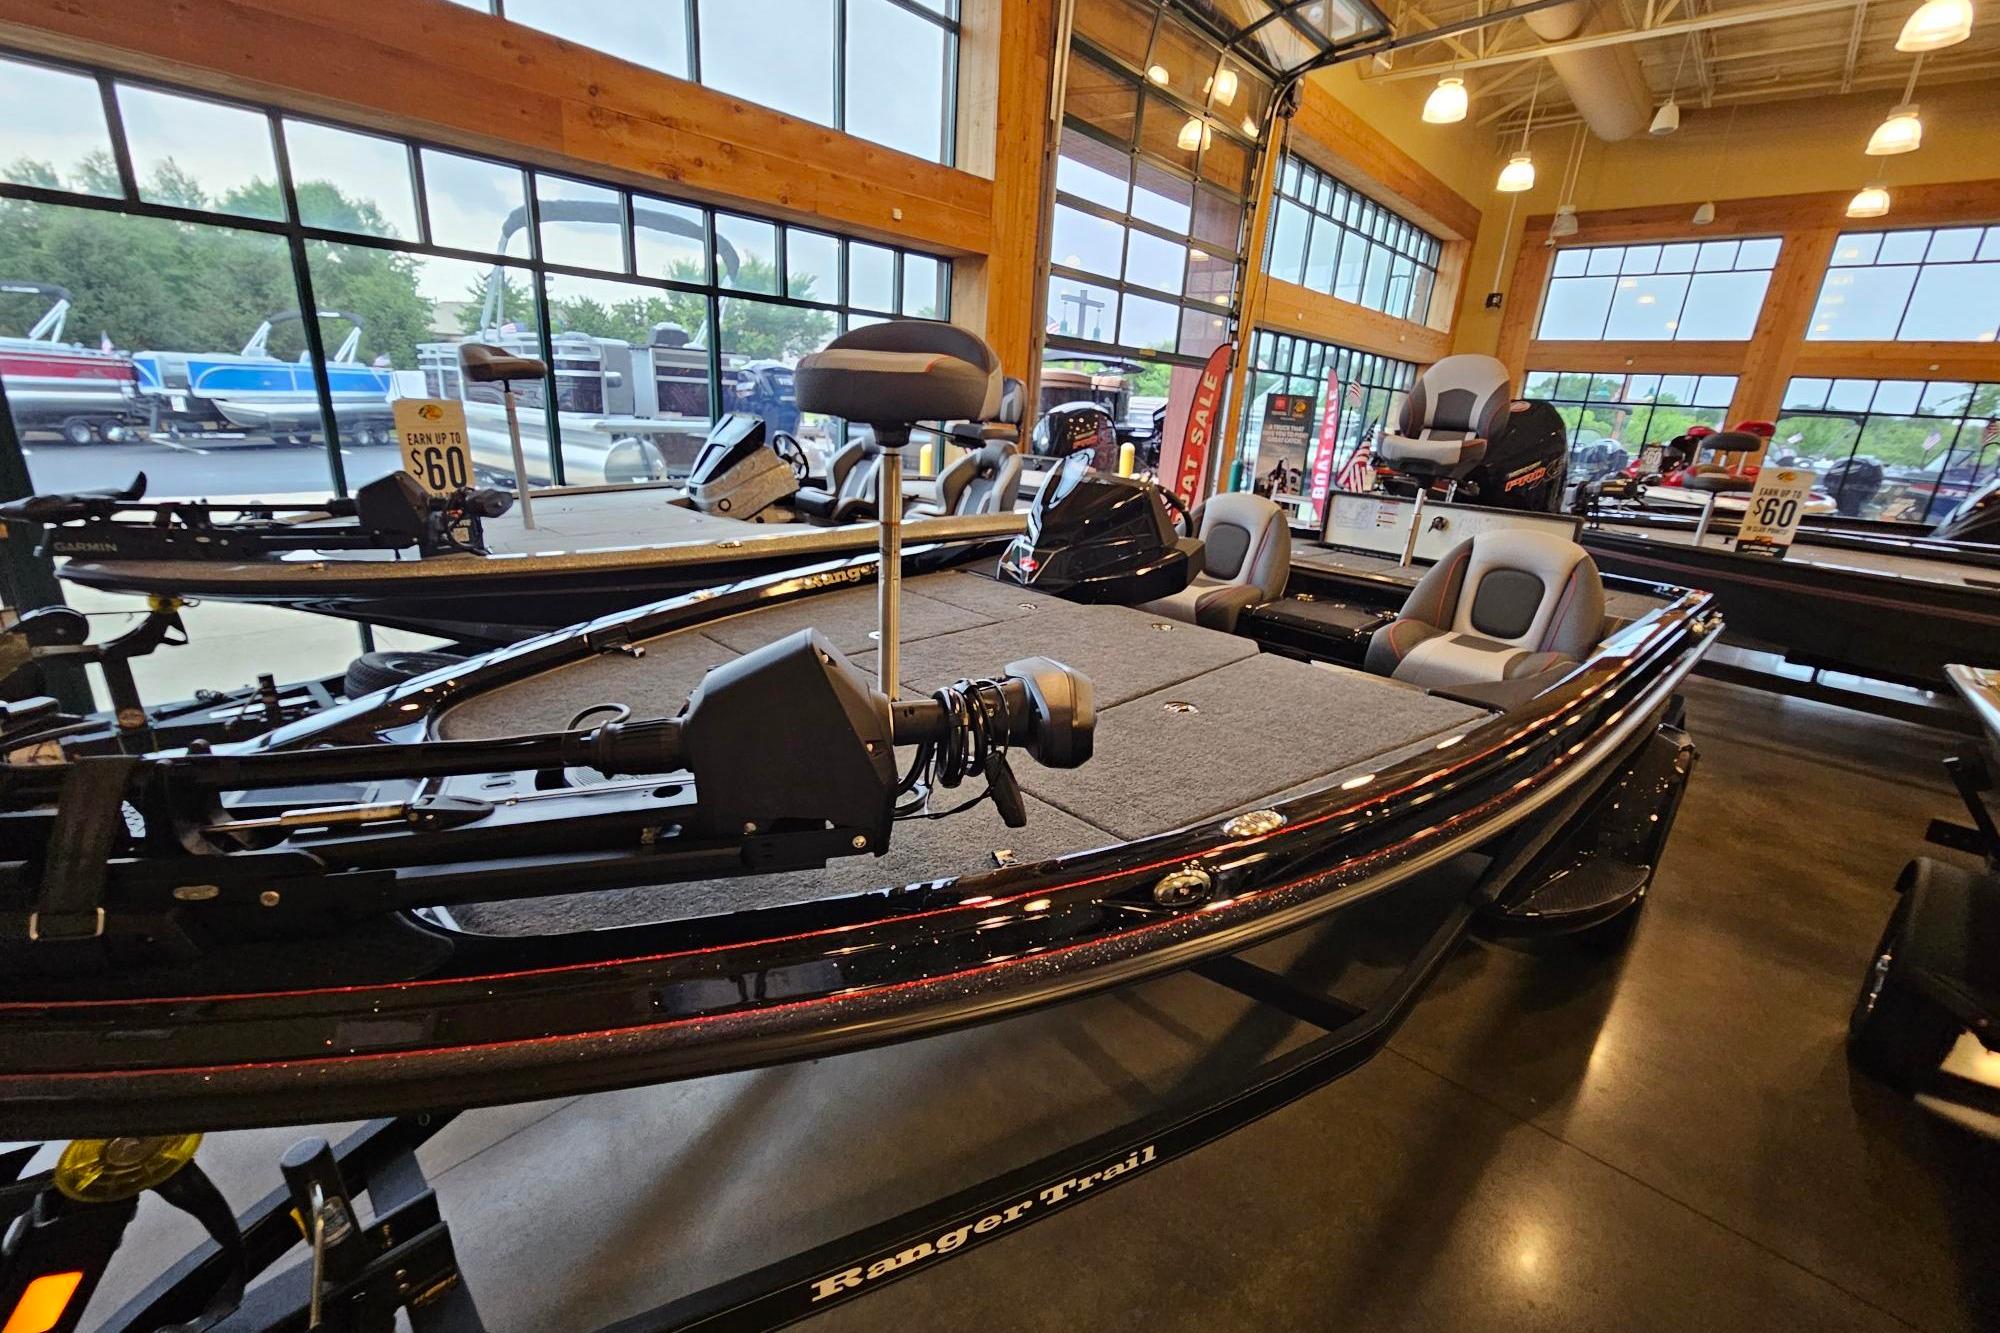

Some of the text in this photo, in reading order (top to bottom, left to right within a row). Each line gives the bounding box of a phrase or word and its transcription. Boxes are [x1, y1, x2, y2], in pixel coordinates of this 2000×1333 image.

[1192, 371, 1218, 446] SALE
[407, 432, 461, 445] EARN UP TO
[1312, 388, 1338, 499] BOAT SALE
[411, 446, 467, 491] $60
[1760, 487, 1802, 499] EARN UP TO
[1753, 497, 1798, 527] $60
[53, 542, 118, 552] GARMIN
[811, 1145, 1156, 1302] Ranger Trail
